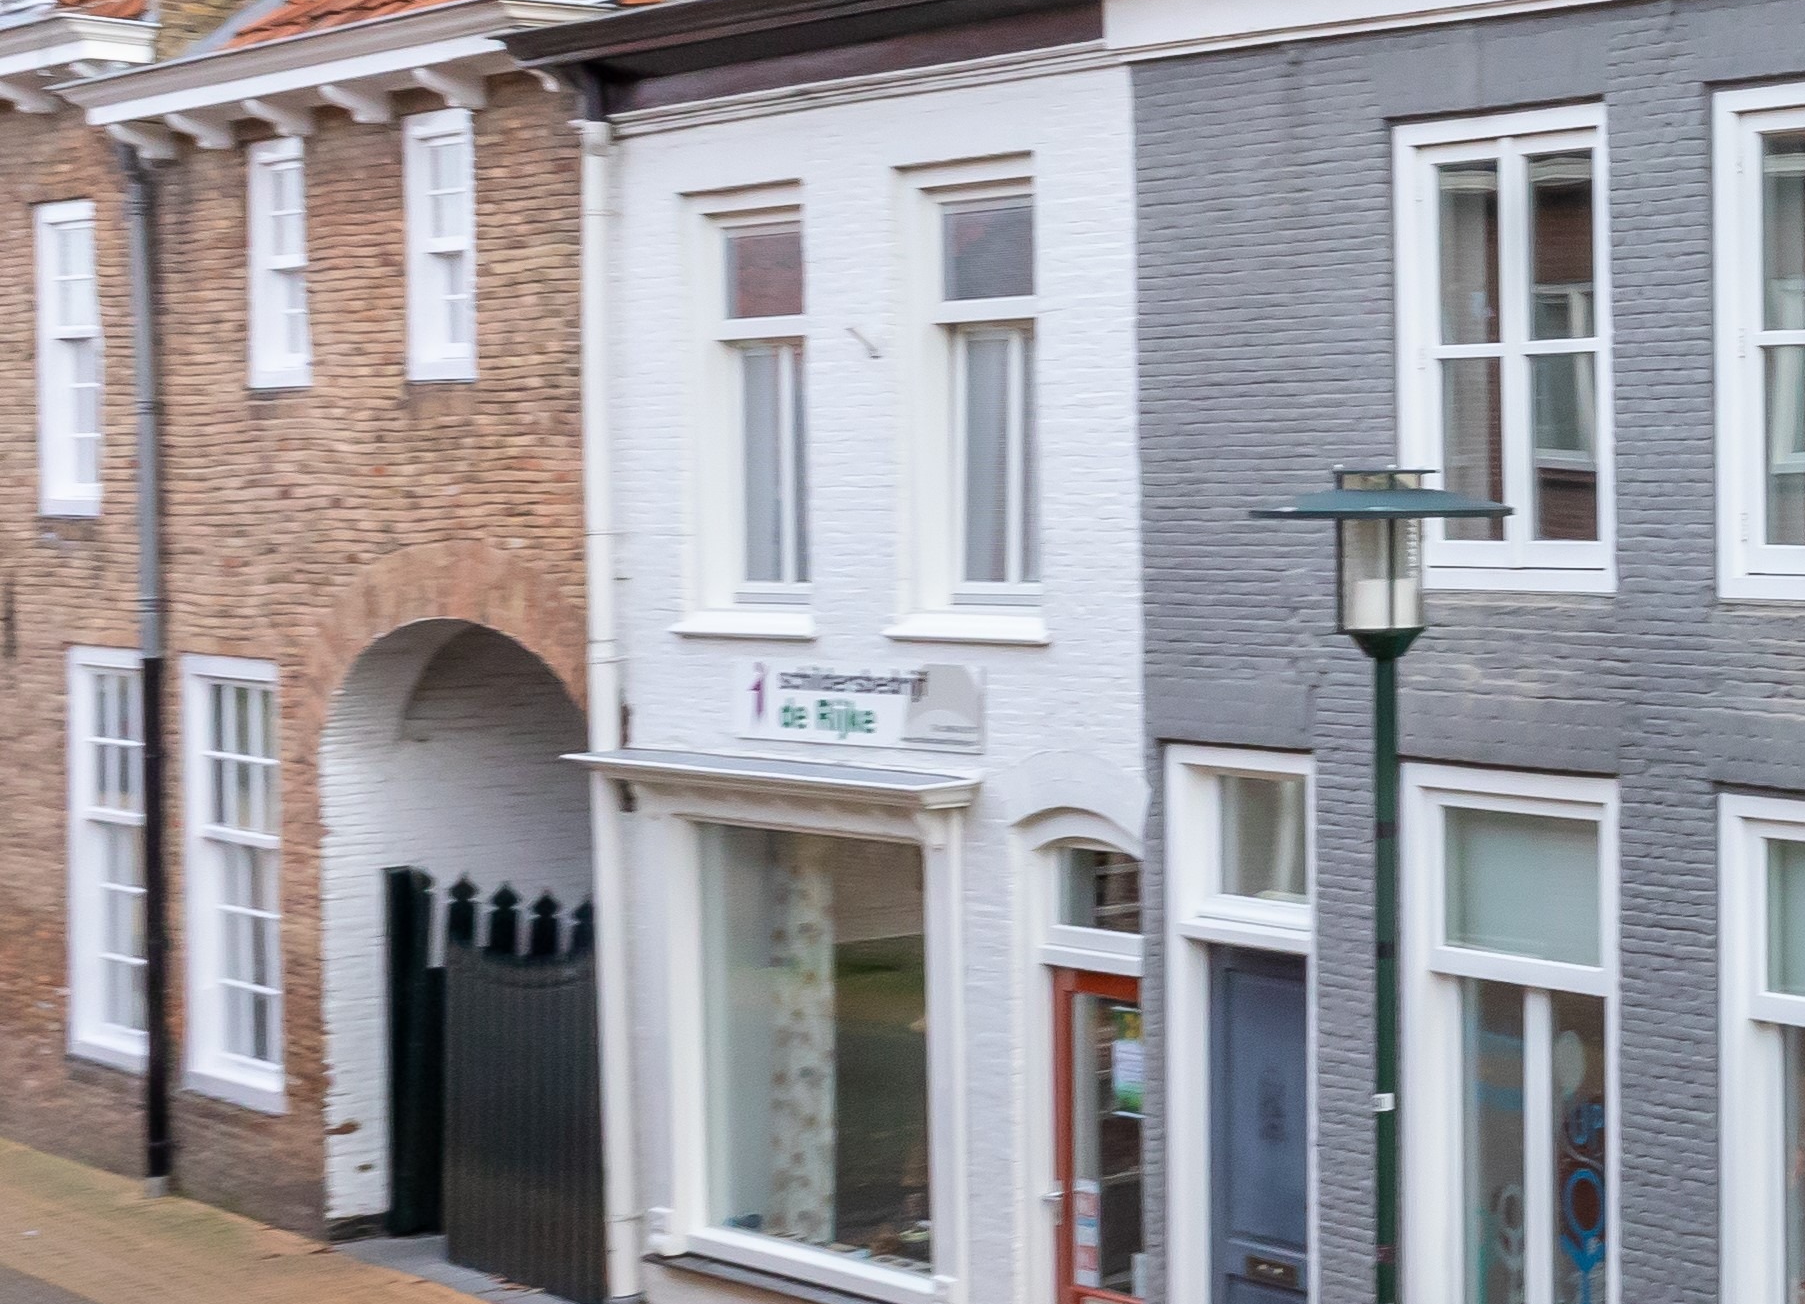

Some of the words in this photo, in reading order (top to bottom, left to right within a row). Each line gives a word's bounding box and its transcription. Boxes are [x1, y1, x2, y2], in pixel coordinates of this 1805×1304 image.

[779, 665, 929, 702] schildersbedrijf
[779, 697, 809, 729] de
[815, 697, 877, 740] Rijke
